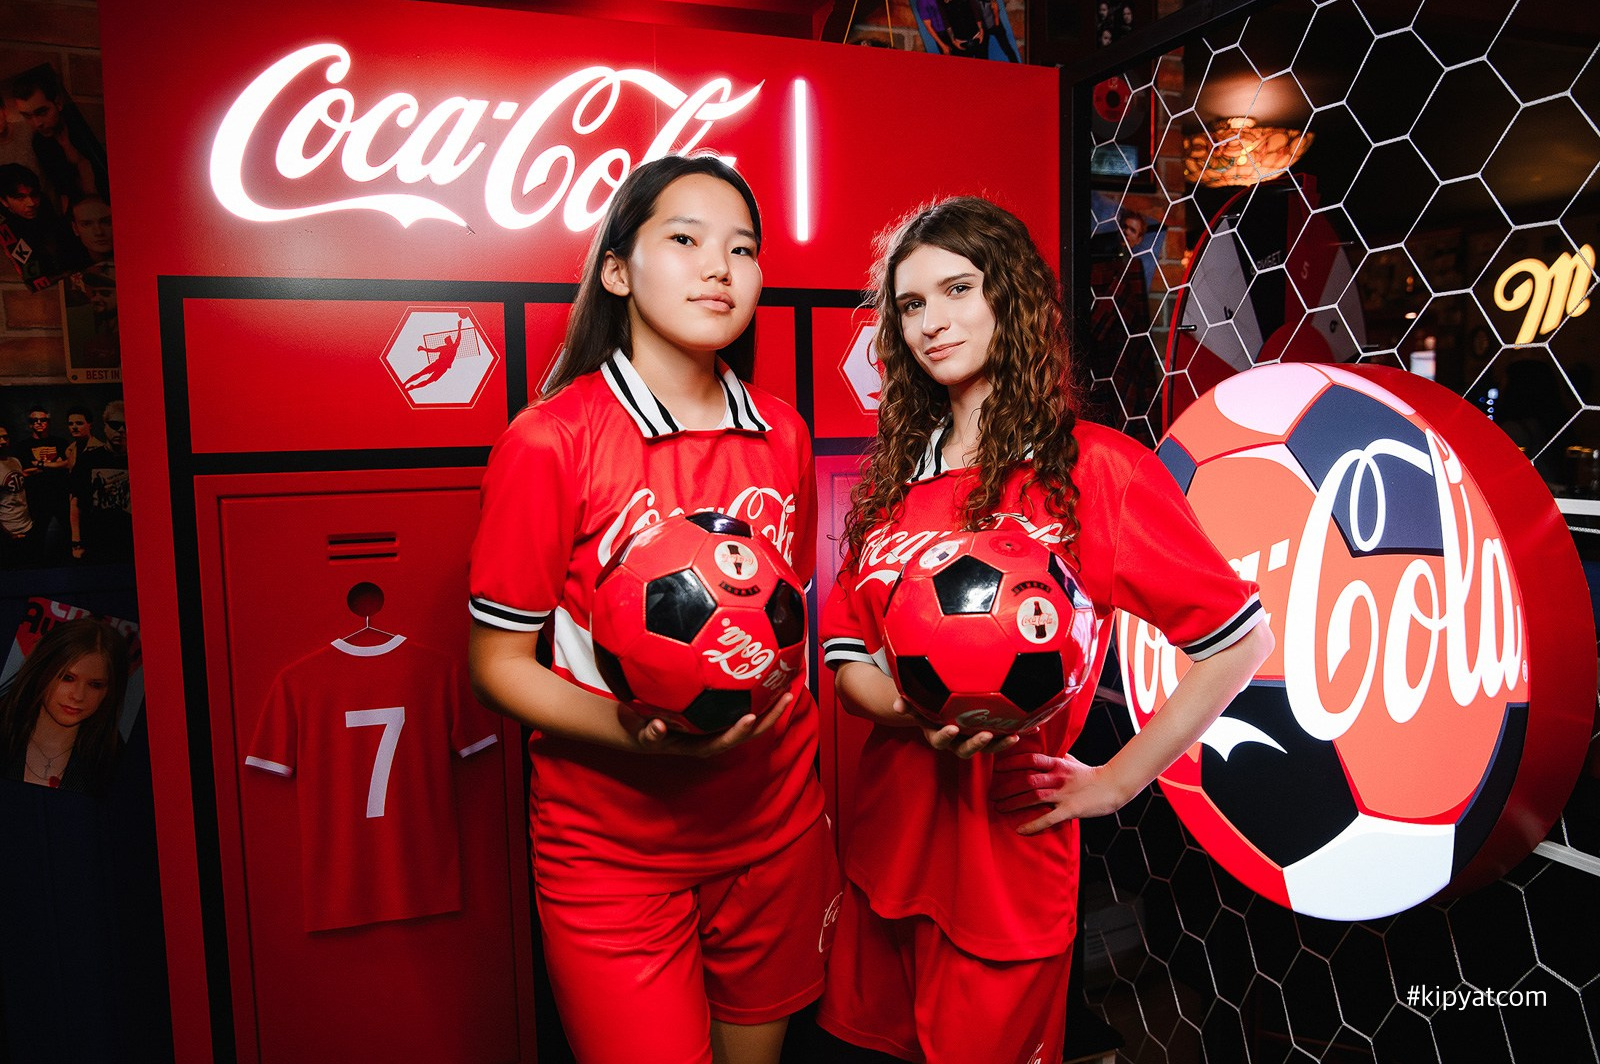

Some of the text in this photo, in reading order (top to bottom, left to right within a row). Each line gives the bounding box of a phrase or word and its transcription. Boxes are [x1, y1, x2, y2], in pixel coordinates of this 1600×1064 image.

[210, 44, 765, 232] Coca-Col
[86, 370, 109, 380] BEST
[345, 706, 405, 818] 7
